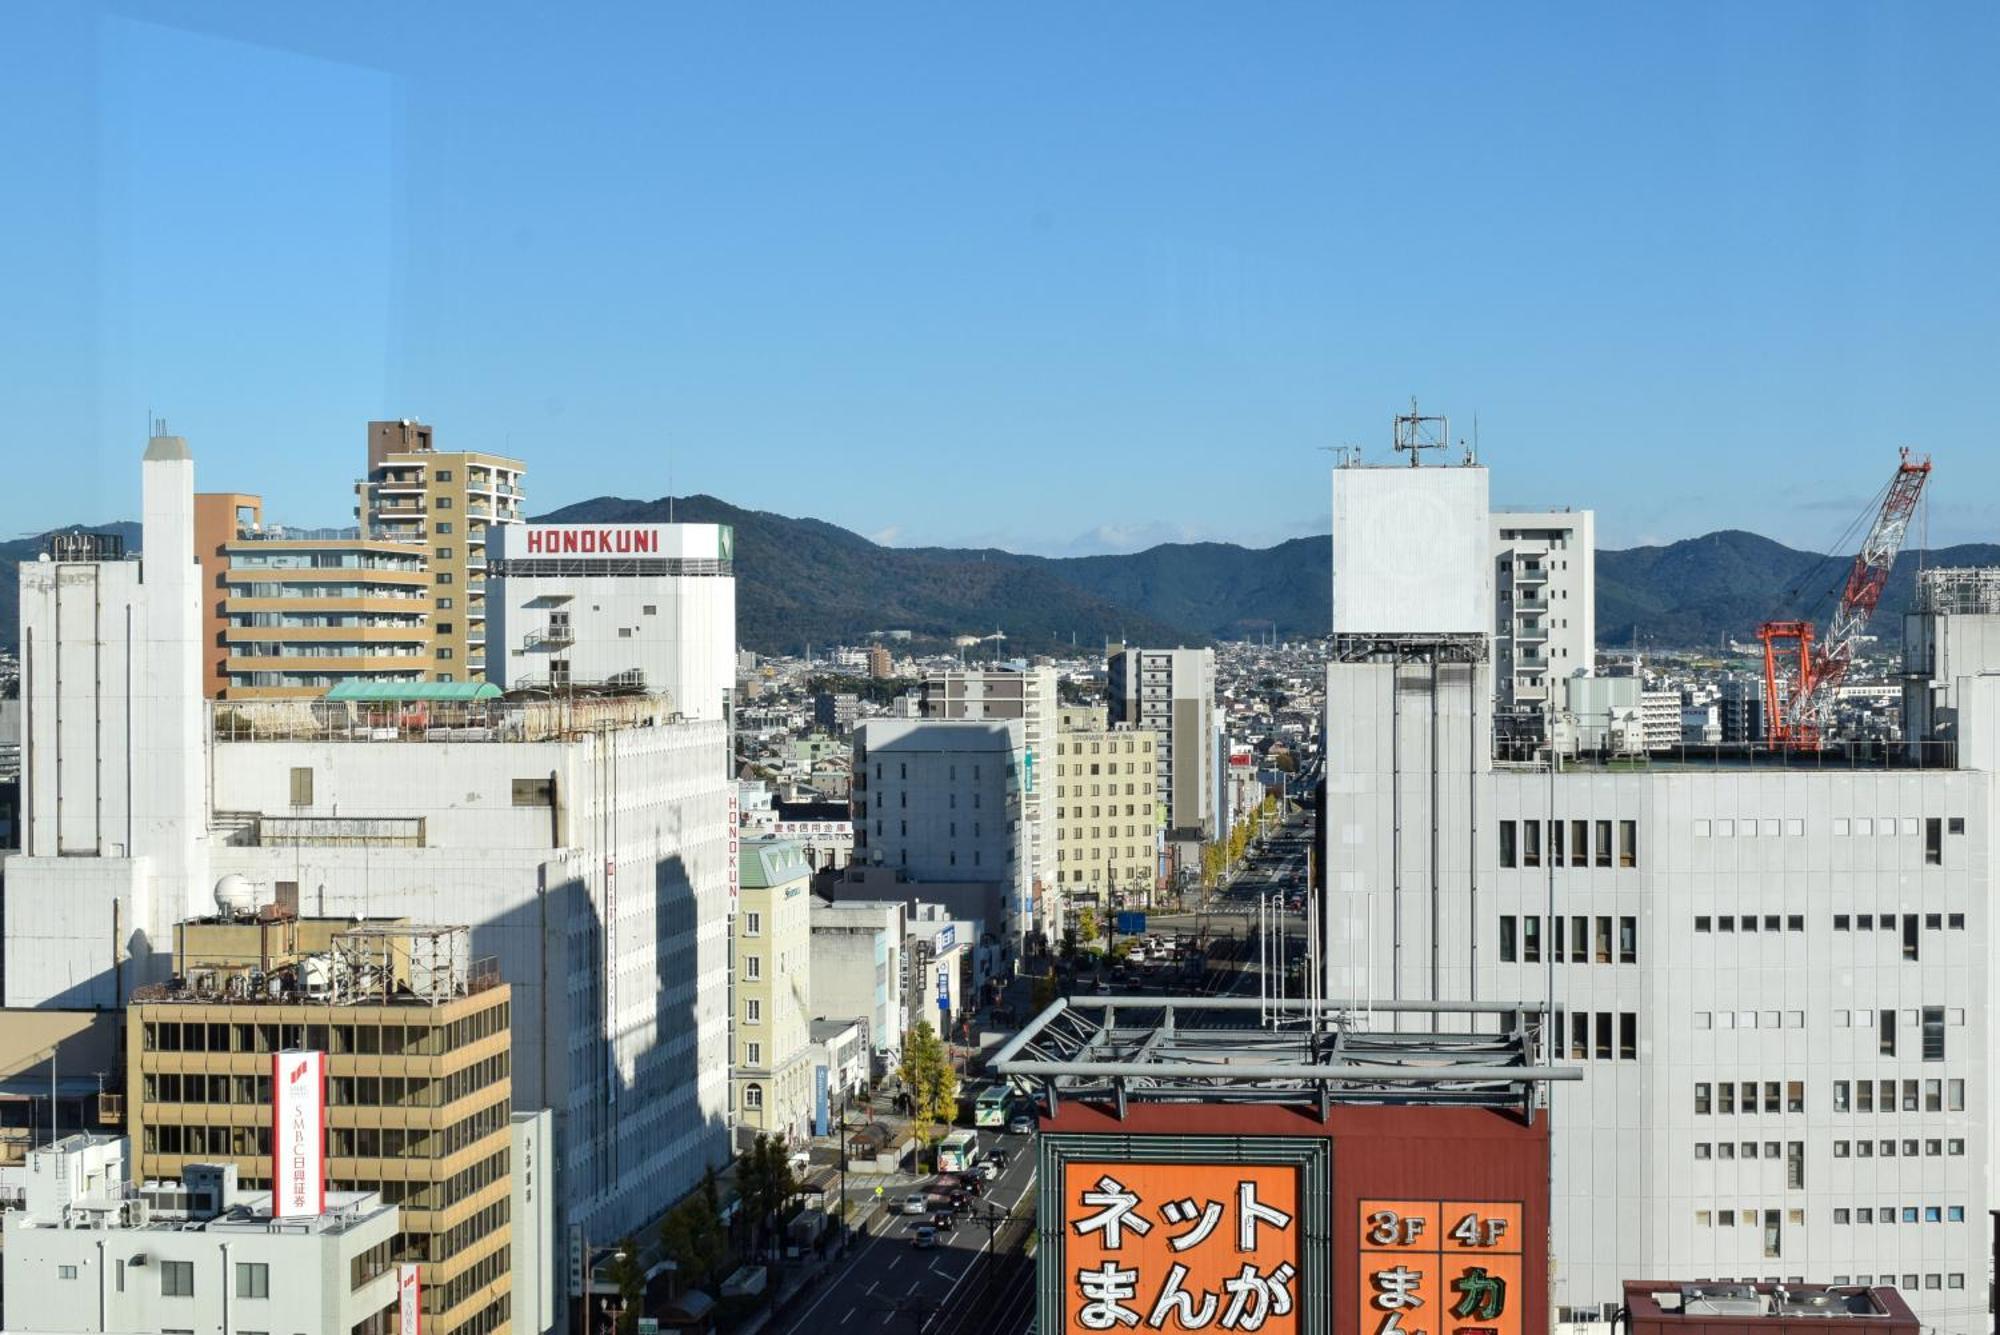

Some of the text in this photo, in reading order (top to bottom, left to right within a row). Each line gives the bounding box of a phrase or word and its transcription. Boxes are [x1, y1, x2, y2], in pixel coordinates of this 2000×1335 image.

[527, 530, 658, 553] HONOKUNI
[292, 1105, 306, 1208] SMBC日興証券
[1070, 1174, 1293, 1253] ネット
[1372, 1209, 1426, 1245] 3F
[1454, 1212, 1508, 1247] 4F
[1074, 1259, 1297, 1332] まんが
